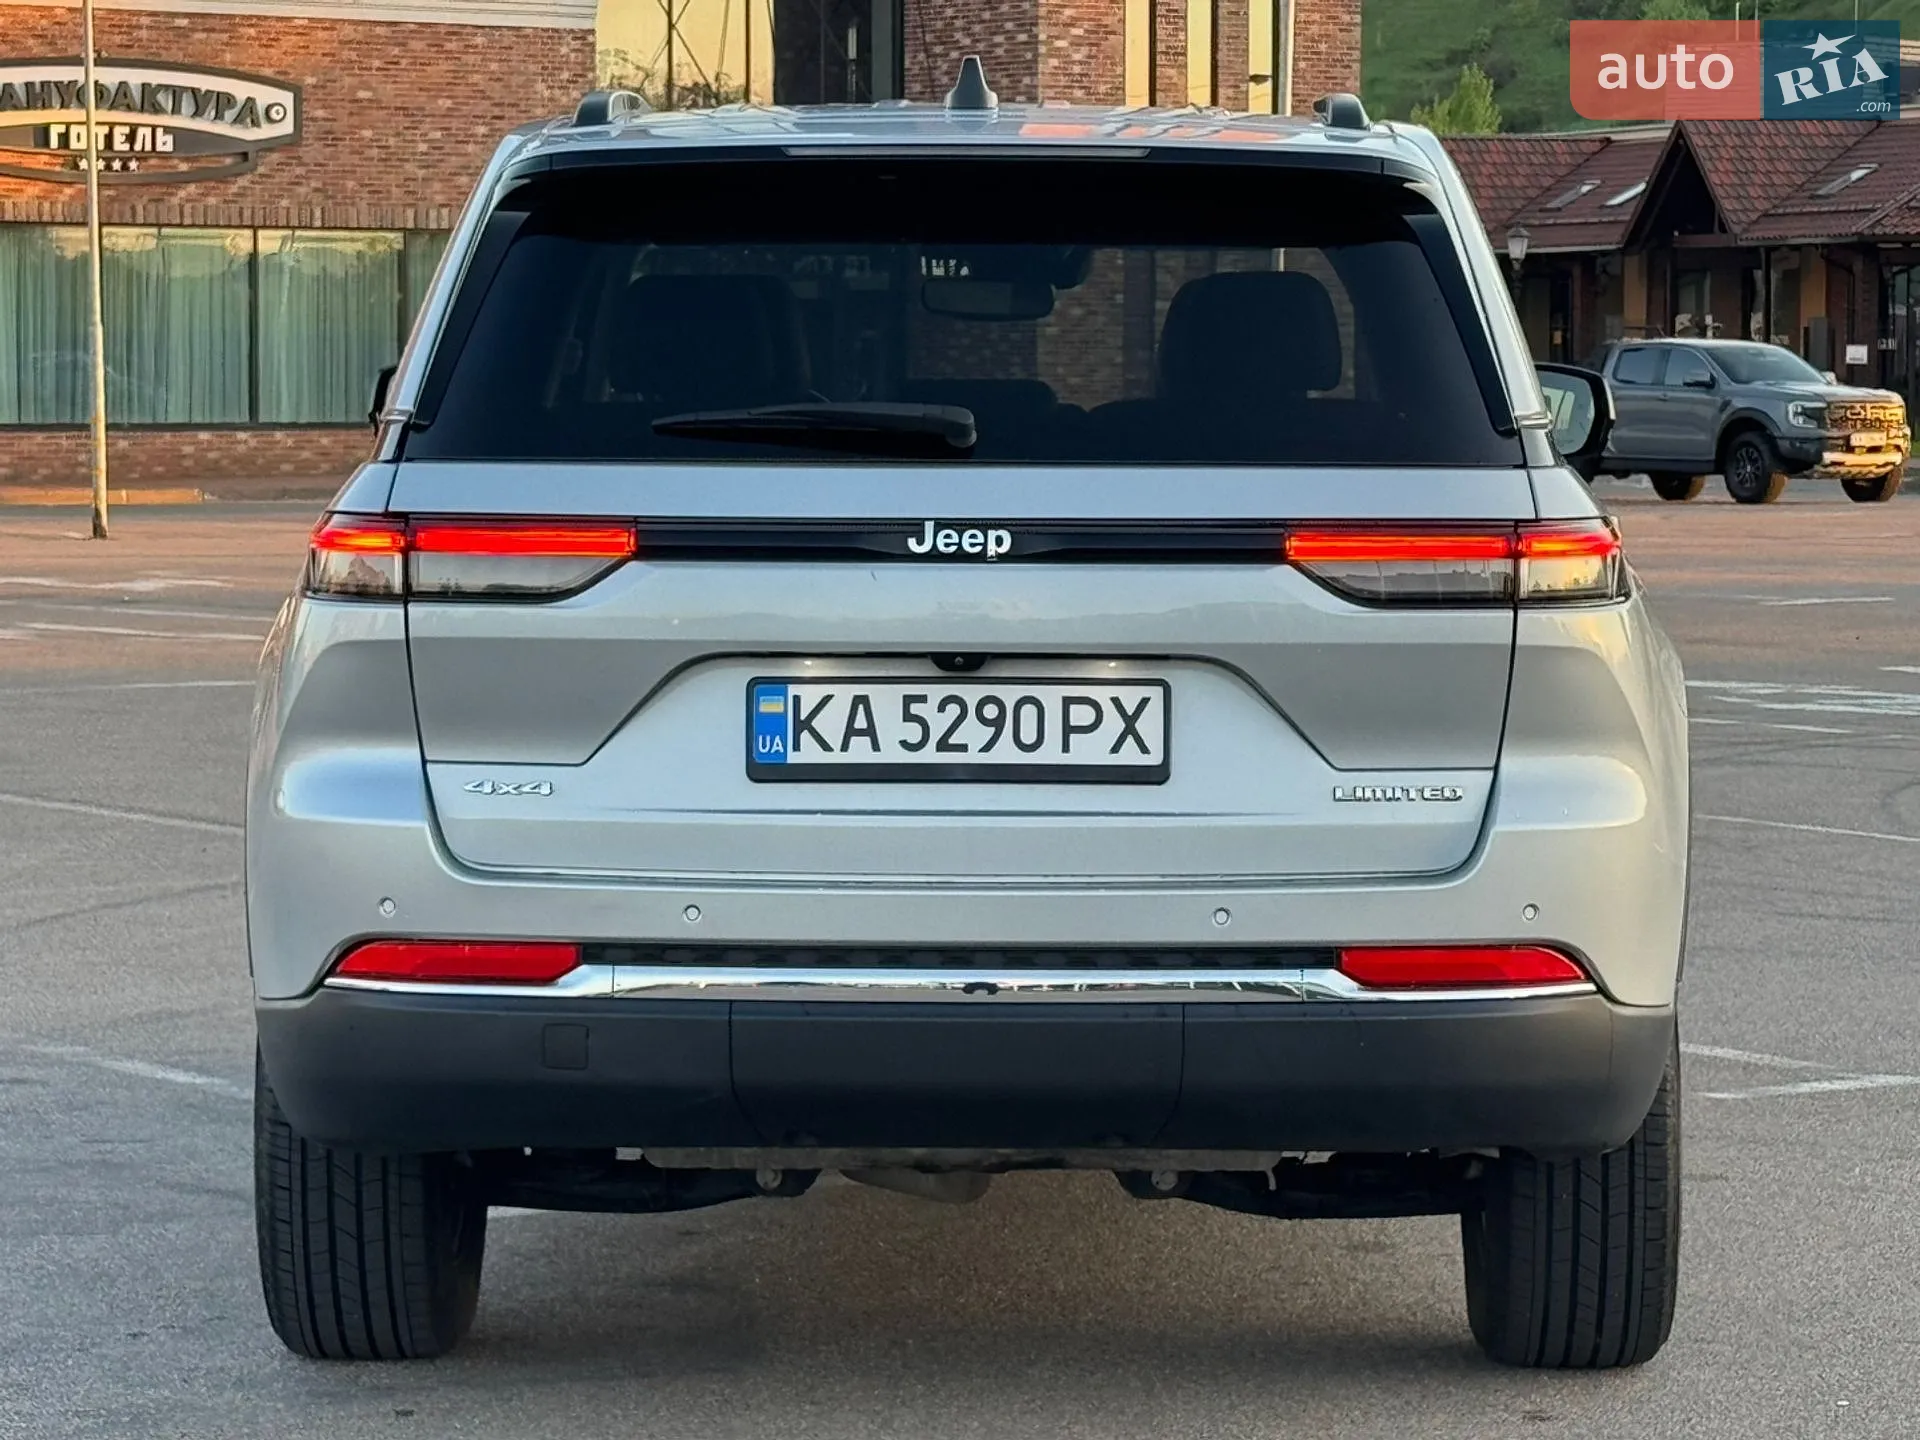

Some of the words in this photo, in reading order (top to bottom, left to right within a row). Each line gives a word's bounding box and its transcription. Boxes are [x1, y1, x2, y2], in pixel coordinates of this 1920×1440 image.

[50, 124, 173, 152] ГОТЕЛЬ
[907, 520, 1012, 561] Jeep
[792, 694, 881, 753] KA
[898, 694, 1046, 753] 5290
[1061, 695, 1152, 754] PX
[758, 735, 784, 754] UA
[463, 780, 553, 796] 4x4
[1334, 786, 1464, 802] LIMITED
